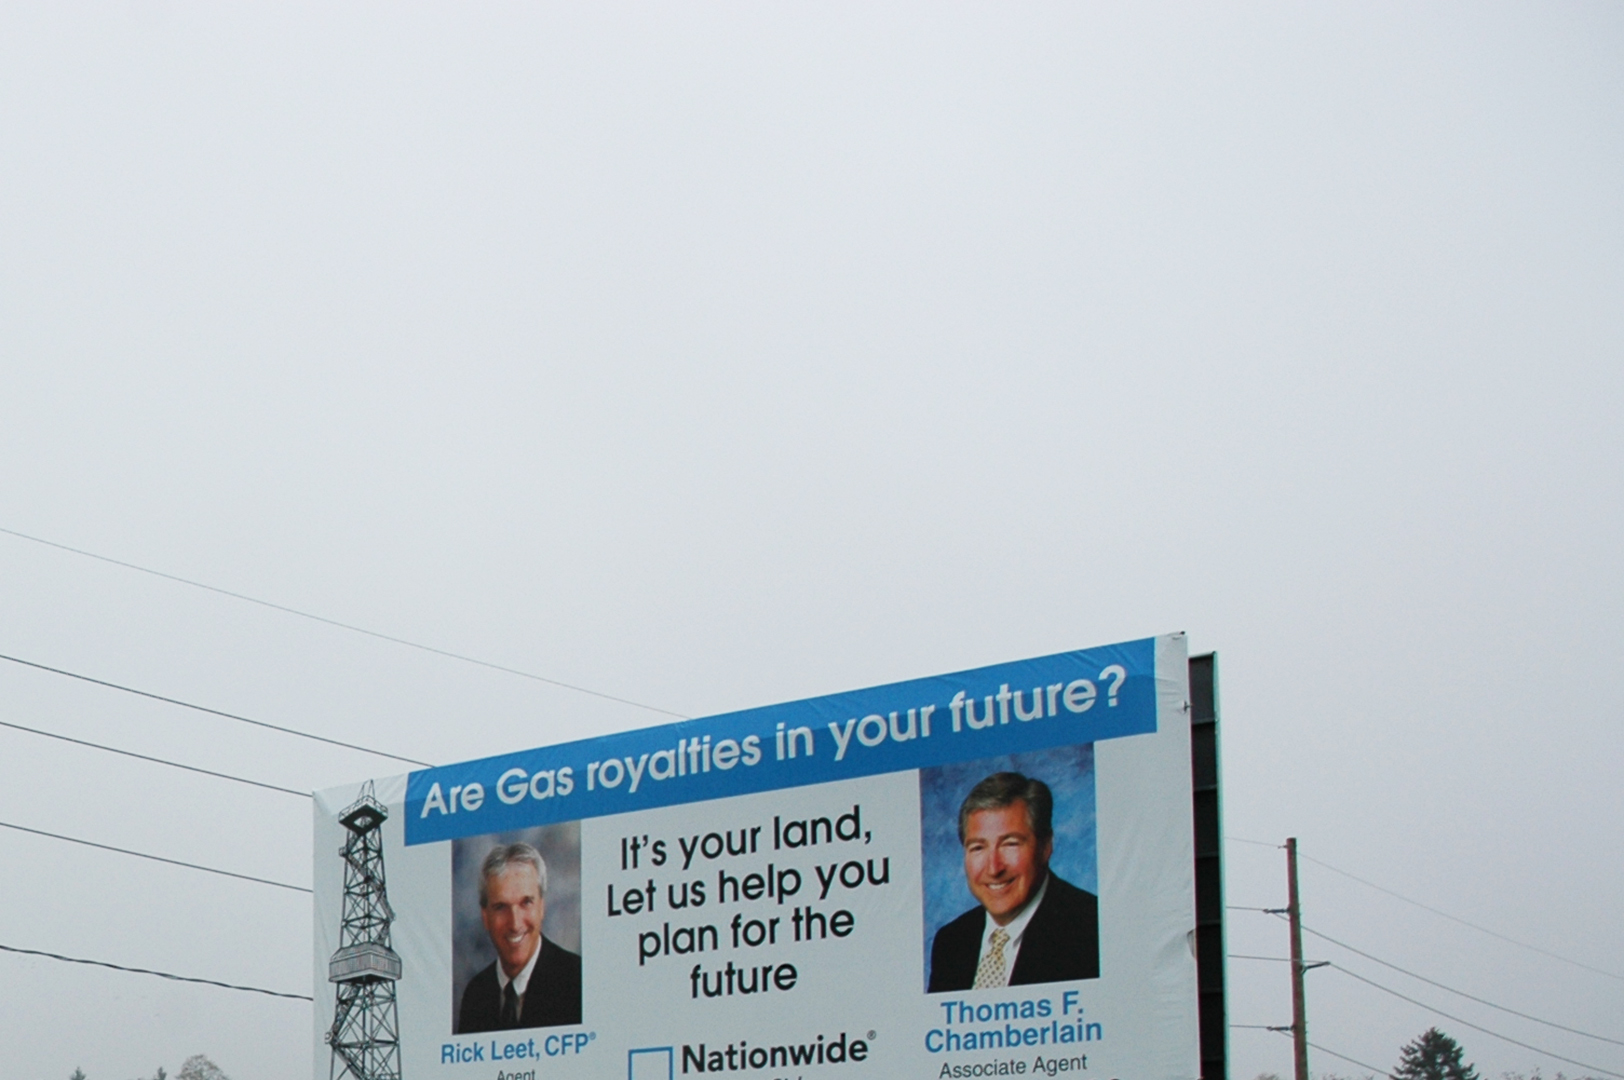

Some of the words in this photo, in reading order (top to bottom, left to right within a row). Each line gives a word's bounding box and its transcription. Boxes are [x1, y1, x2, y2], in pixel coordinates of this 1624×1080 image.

[420, 781, 485, 818] Are
[495, 767, 574, 804] Gas
[586, 734, 762, 793] royalties
[775, 721, 814, 761] in
[828, 703, 935, 761] your
[948, 663, 1127, 733] future?
[621, 834, 668, 871] It's
[678, 825, 762, 871] your
[773, 804, 872, 851] land,
[607, 878, 657, 917] Let
[668, 879, 707, 909] us
[718, 862, 802, 905] help
[814, 856, 890, 901] you
[638, 921, 718, 966] plan
[730, 912, 780, 949] for
[791, 905, 855, 942] the
[689, 961, 798, 999] future
[940, 998, 1052, 1025] Thomas
[1062, 990, 1084, 1016] F.
[441, 1042, 484, 1065] Rick
[491, 1037, 540, 1062] Leet,
[925, 1018, 1103, 1053] Chamberlain
[939, 1059, 1027, 1079] Associate
[1032, 1054, 1087, 1077] Agent
